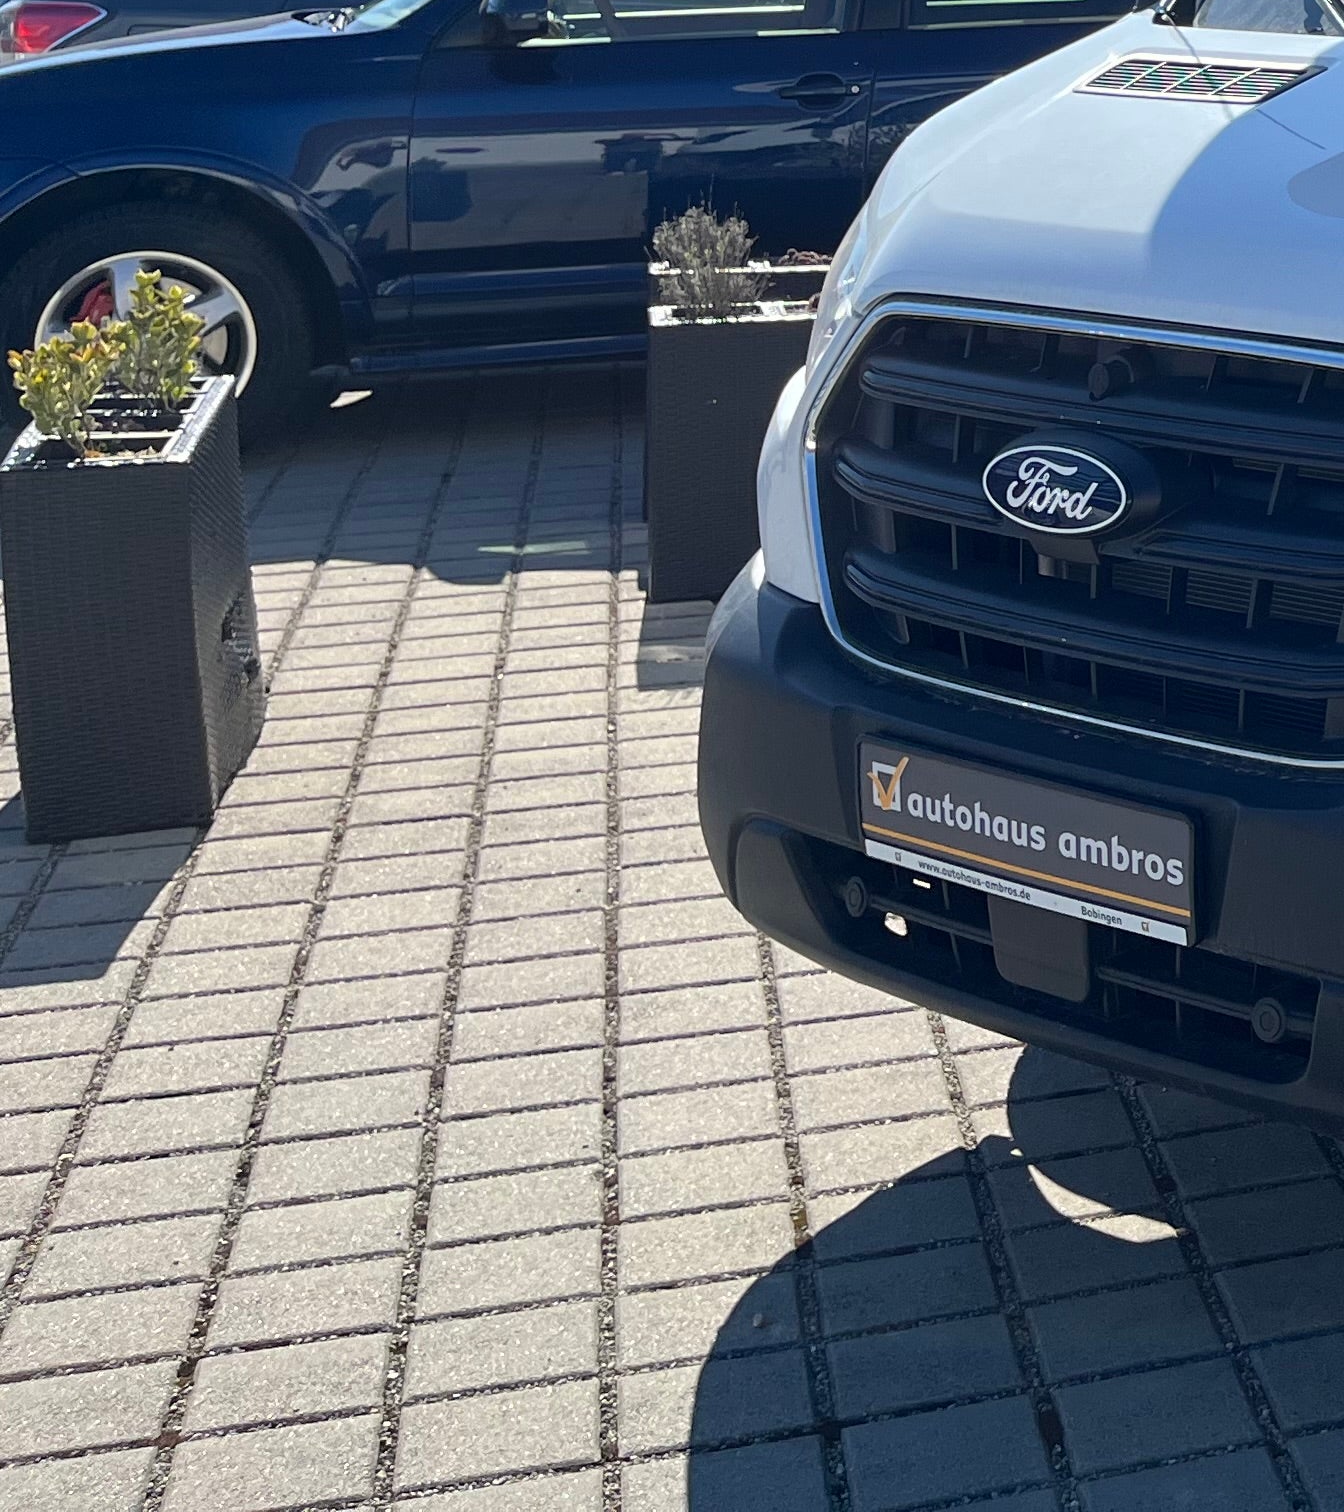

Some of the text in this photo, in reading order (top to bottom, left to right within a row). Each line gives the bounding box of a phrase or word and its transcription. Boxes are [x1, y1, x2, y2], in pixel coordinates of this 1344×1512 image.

[1006, 456, 1099, 520] Ford
[906, 788, 1185, 886] autohaus ambros
[917, 859, 1123, 925] www.autohaus-ambros.de Bobingen
